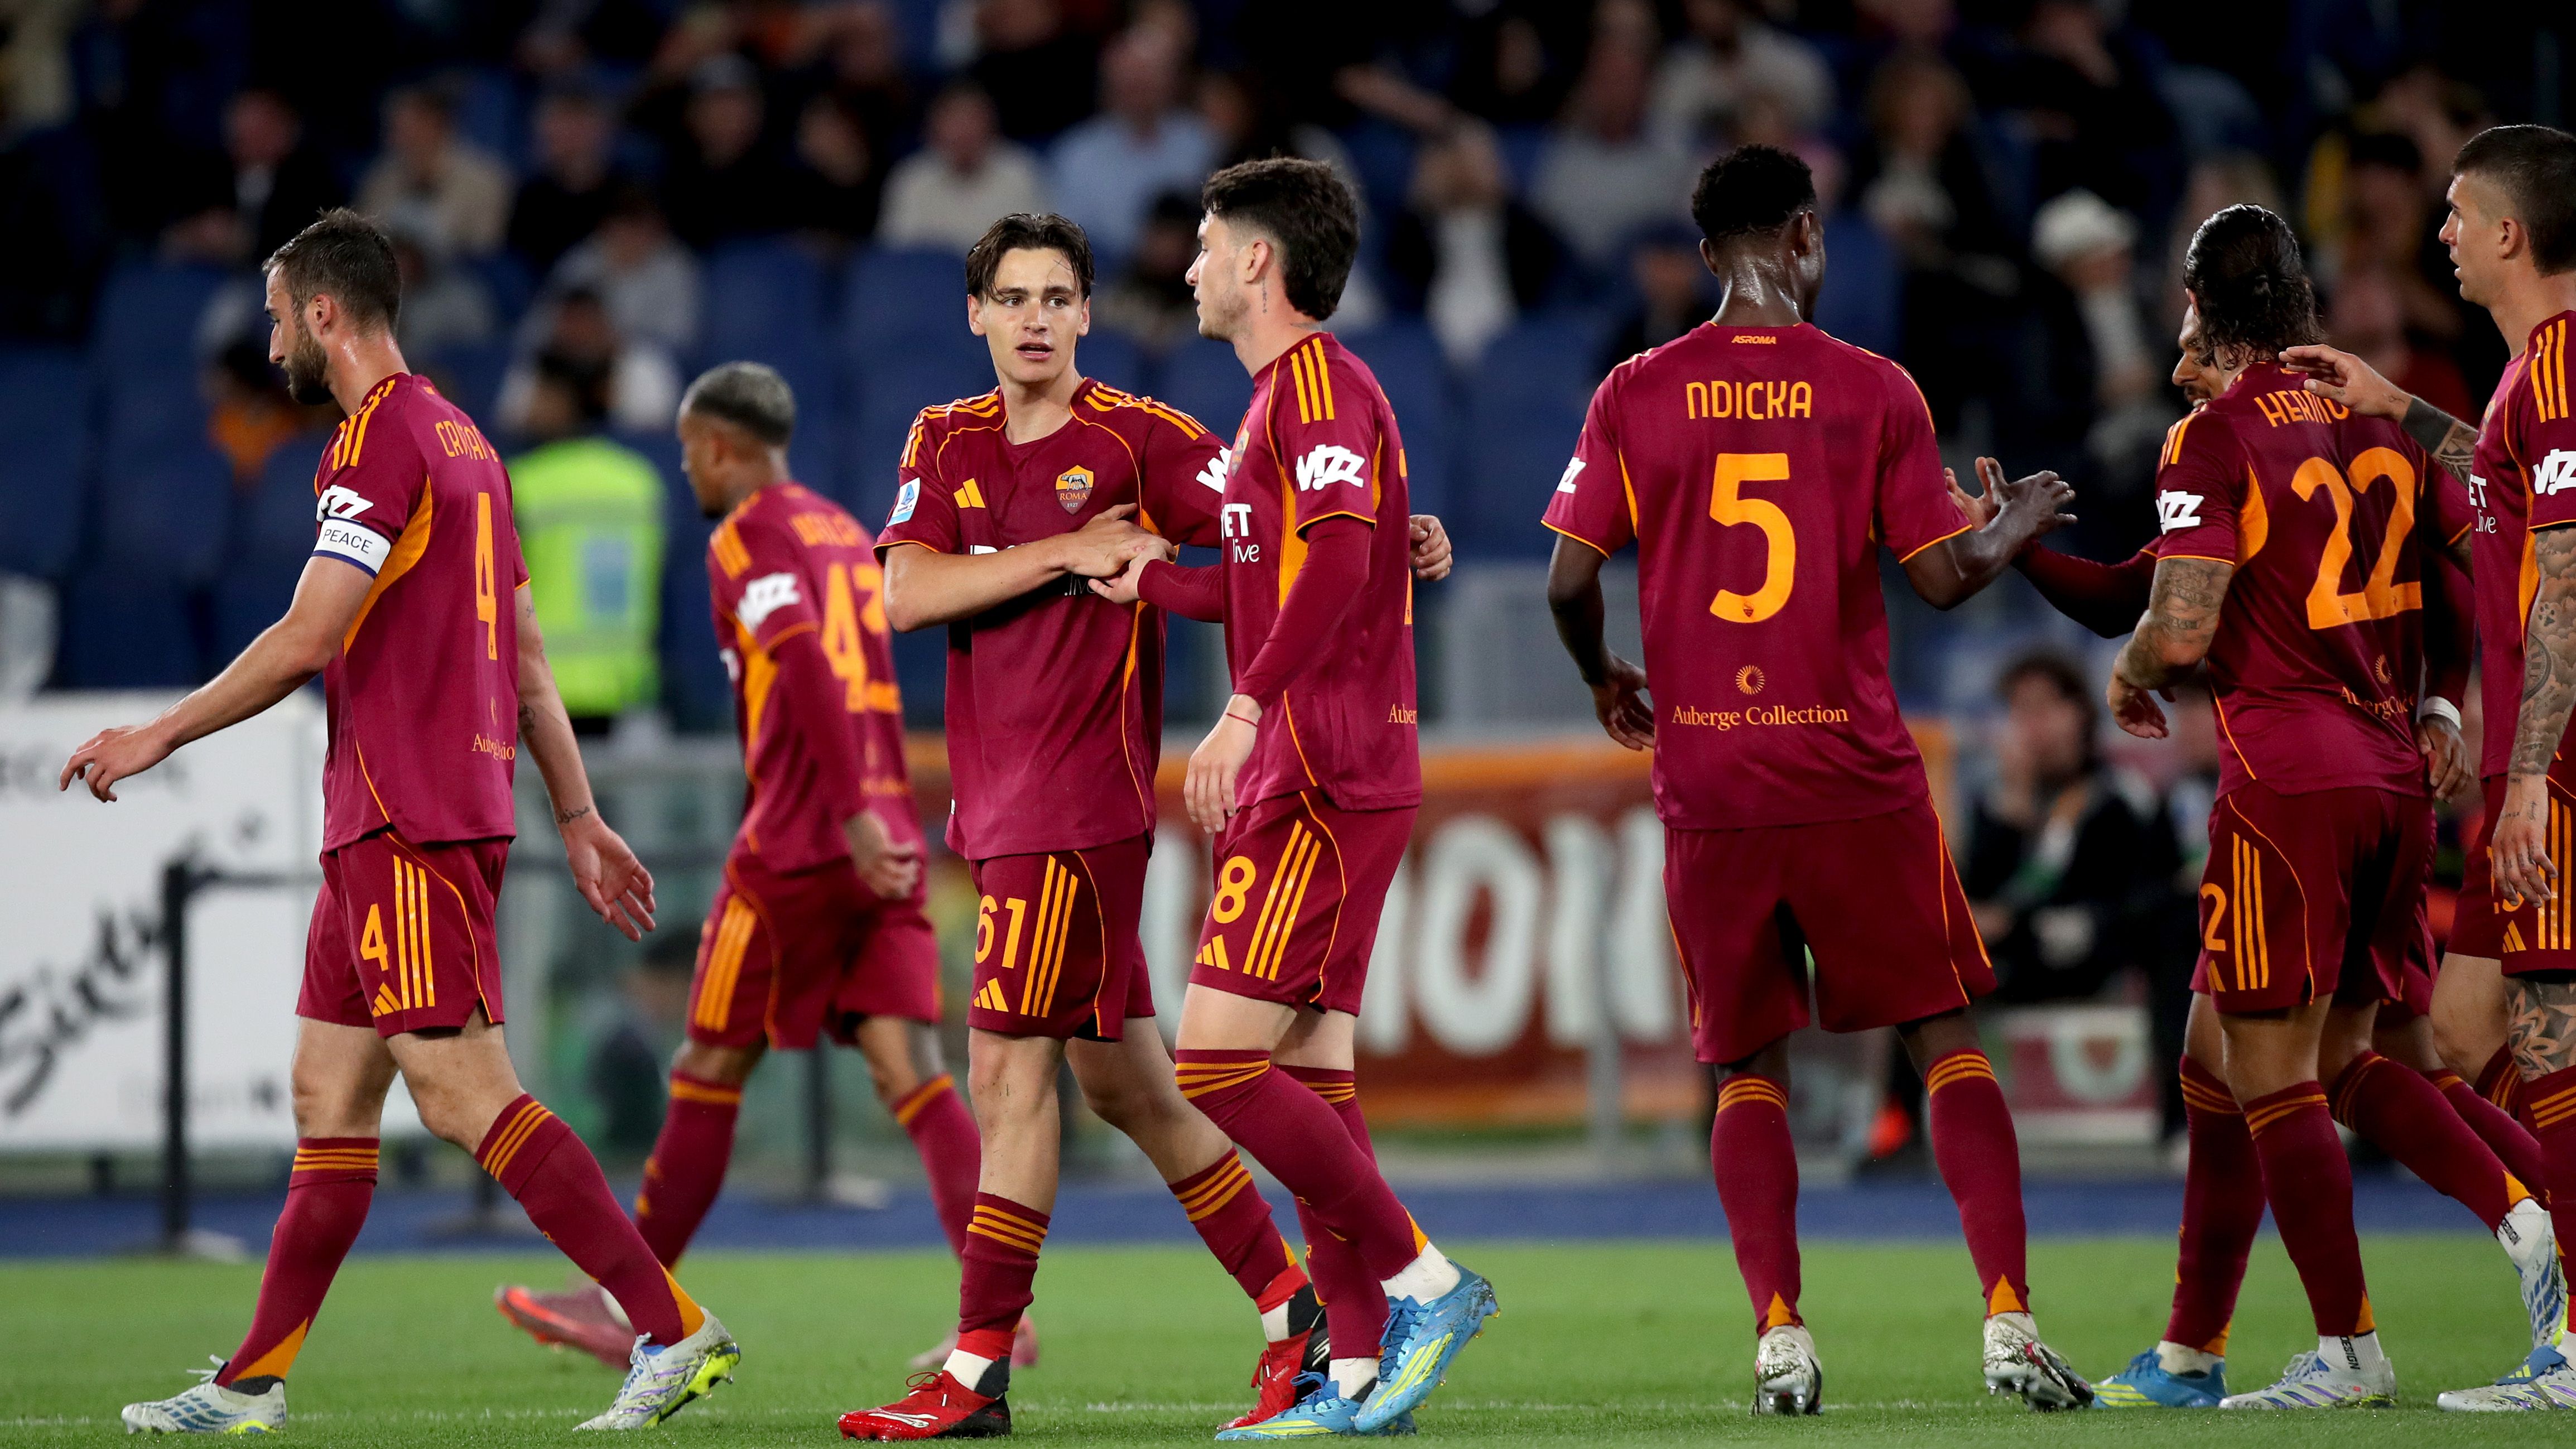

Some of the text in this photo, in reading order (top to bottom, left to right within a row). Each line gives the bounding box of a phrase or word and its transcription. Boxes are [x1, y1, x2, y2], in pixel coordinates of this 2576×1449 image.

[1686, 381, 1813, 420] NDICKA
[1060, 492, 1087, 500] ROMA
[322, 529, 373, 554] PEACE
[1709, 453, 1796, 623] 5
[2291, 446, 2423, 630] 22
[475, 492, 497, 660] 4
[1672, 704, 1849, 731] Auberge Collection
[1206, 855, 1256, 924] 8
[360, 903, 389, 972] 4
[975, 894, 1027, 969] 61
